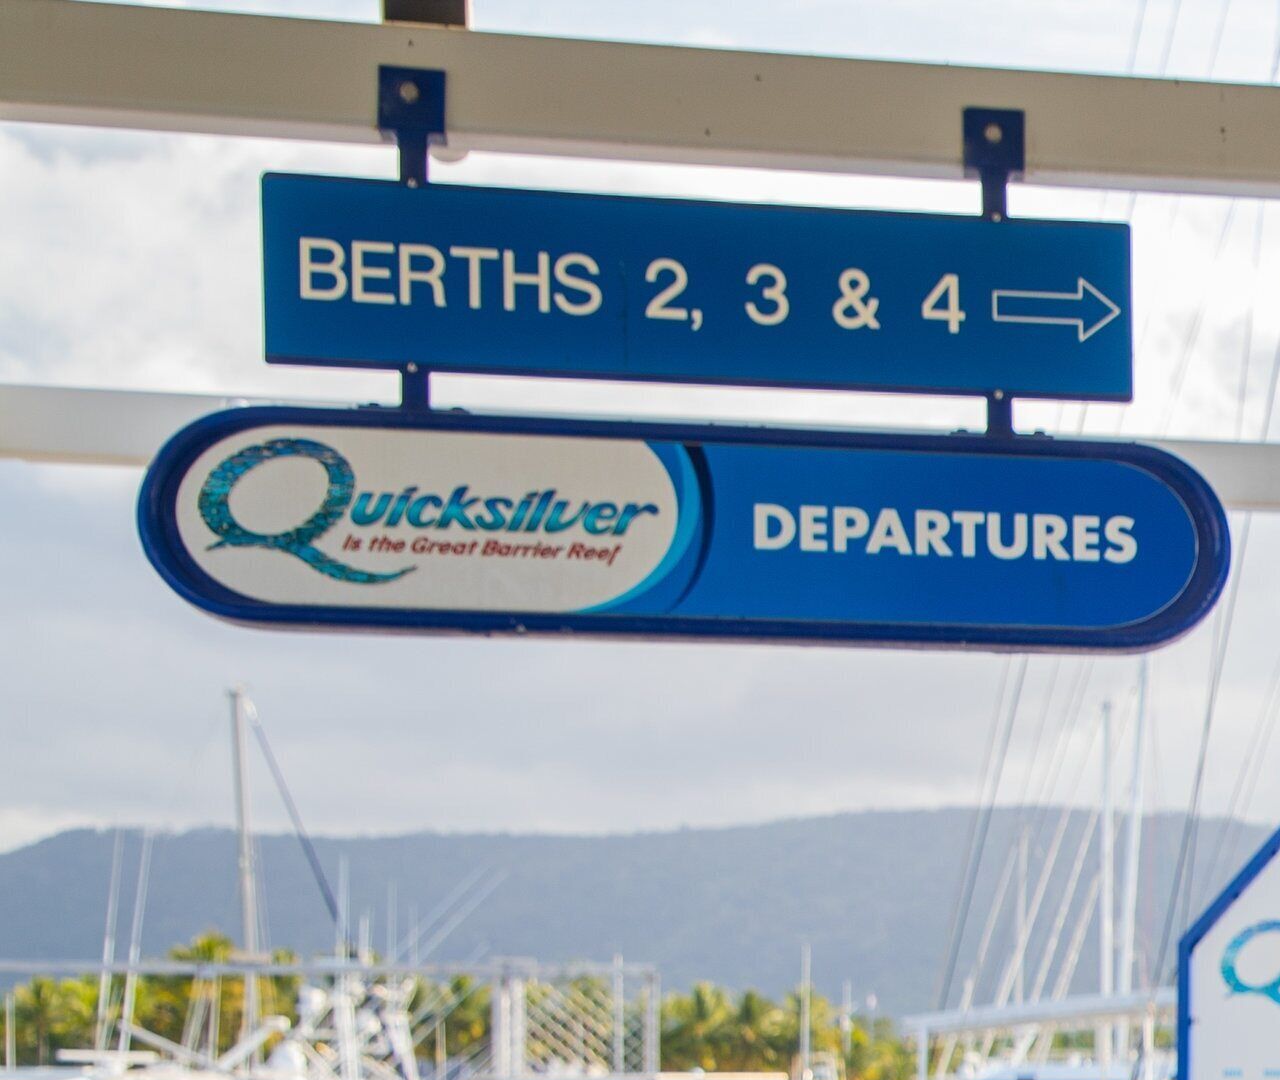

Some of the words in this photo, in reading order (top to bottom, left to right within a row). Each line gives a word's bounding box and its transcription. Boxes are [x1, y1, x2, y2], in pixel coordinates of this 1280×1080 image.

[297, 236, 604, 318] BERTHS
[644, 257, 705, 330] 2,
[744, 263, 792, 327] 3
[833, 269, 882, 330] &
[921, 273, 967, 334] 4
[198, 438, 660, 584] Quicksilver
[343, 533, 363, 552] Is
[369, 536, 406, 553] the
[410, 537, 478, 555] Great
[481, 540, 560, 560] Barrier
[566, 541, 622, 566] Reef
[753, 503, 1139, 565] DEPARTURES
